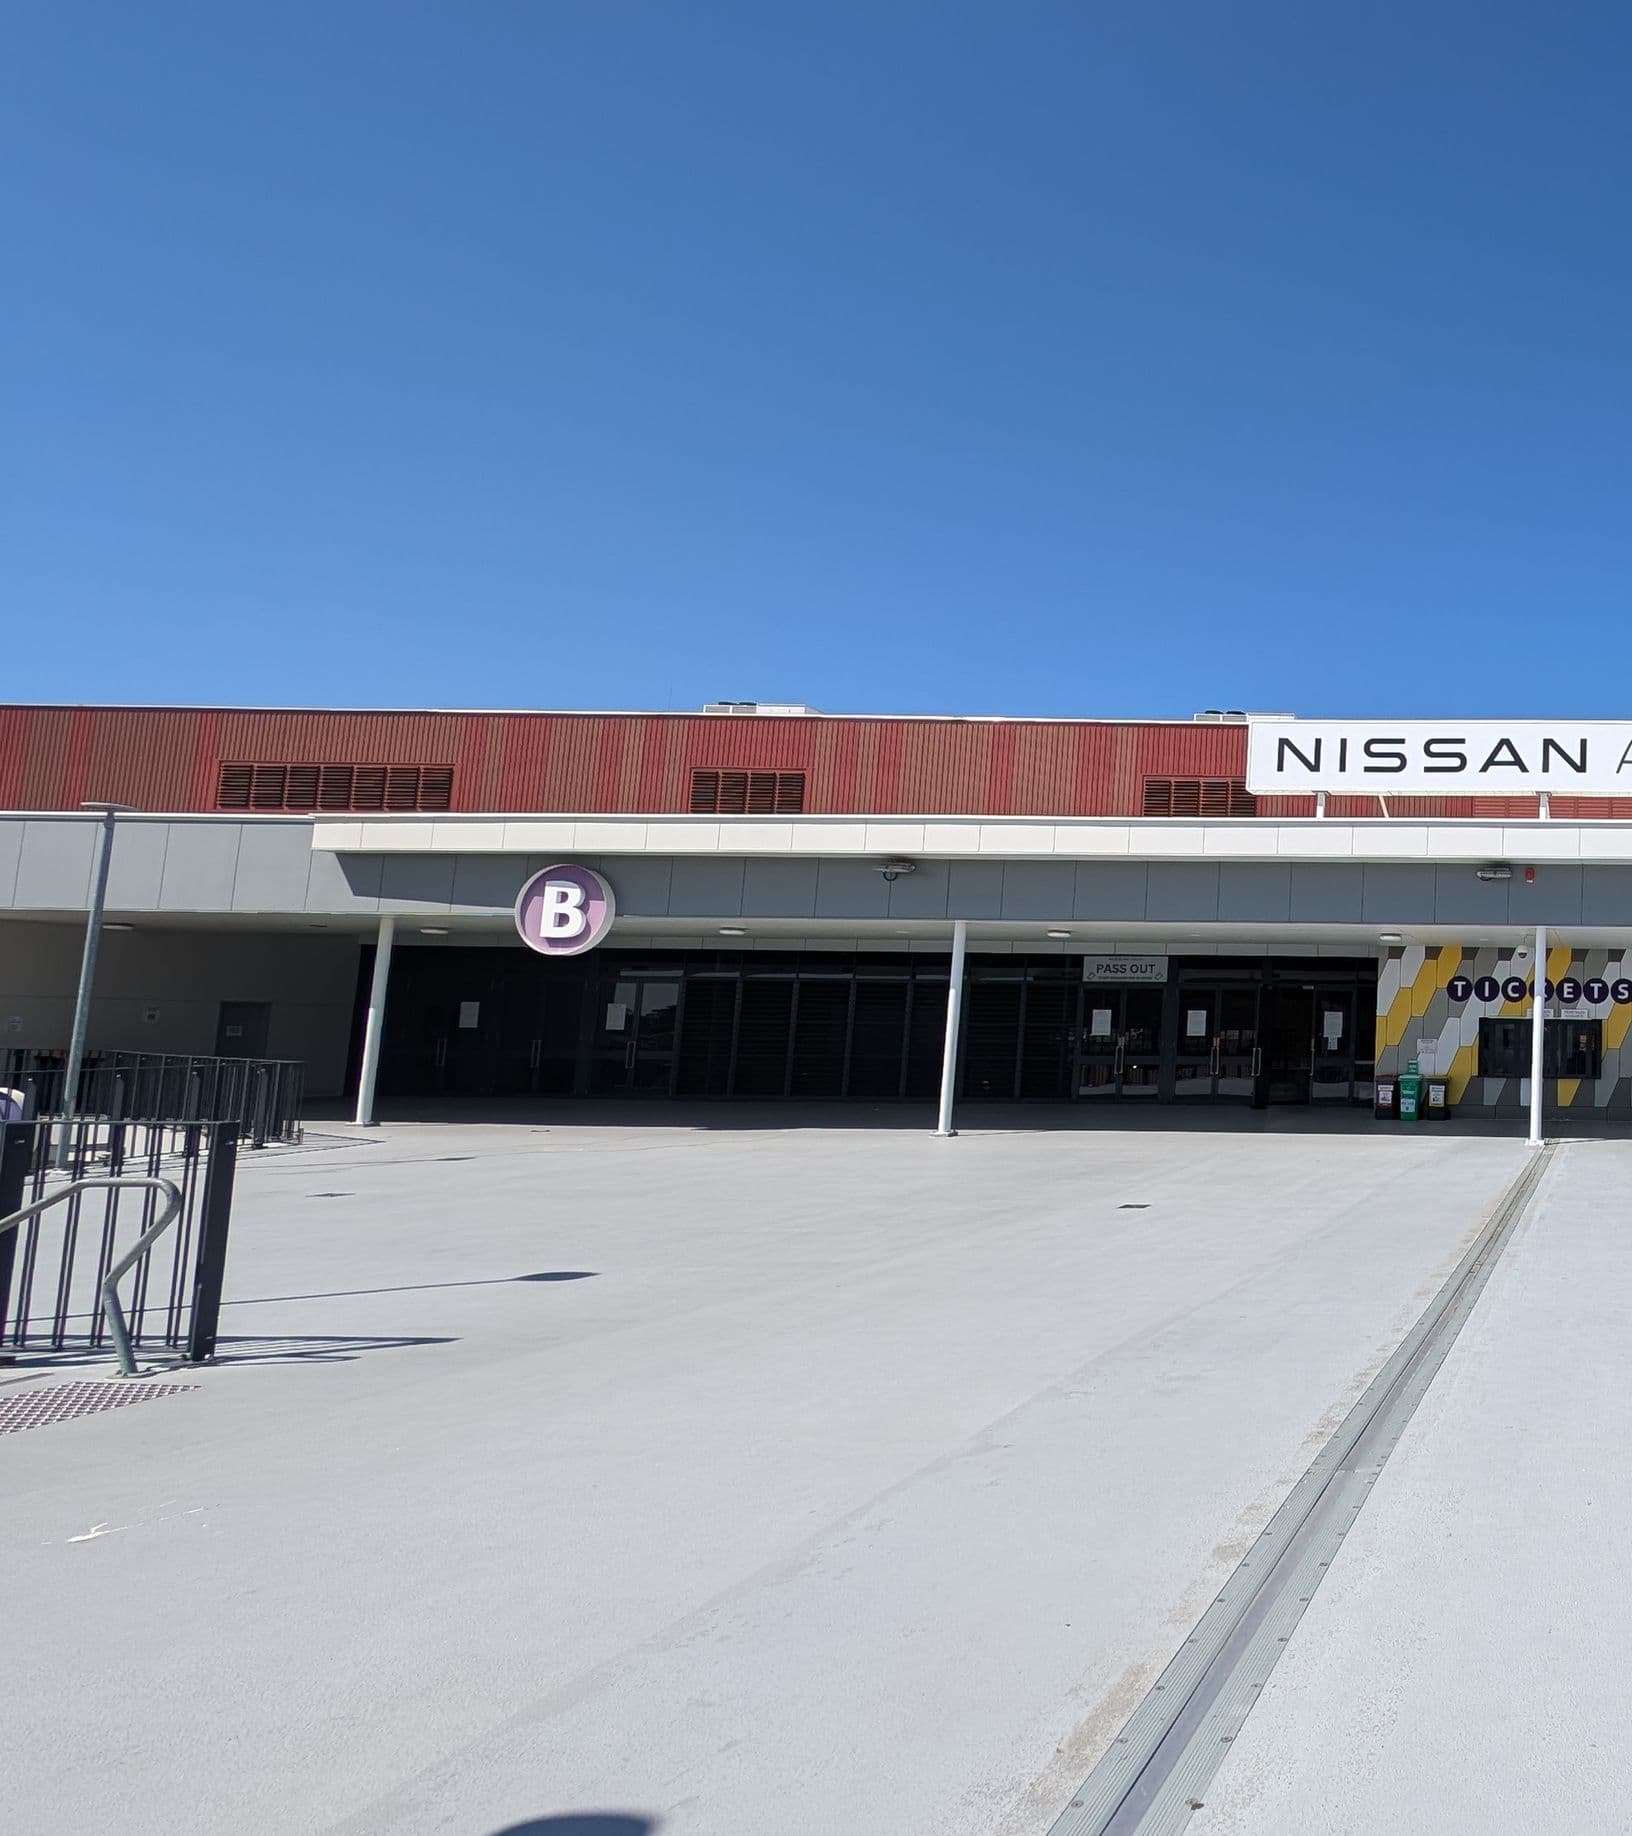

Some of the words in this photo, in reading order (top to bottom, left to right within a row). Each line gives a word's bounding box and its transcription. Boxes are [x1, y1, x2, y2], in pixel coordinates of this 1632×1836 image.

[1277, 738, 1587, 773] NISSAN
[540, 880, 587, 938] B
[1096, 963, 1127, 974] PASS
[1129, 963, 1156, 974] OUT
